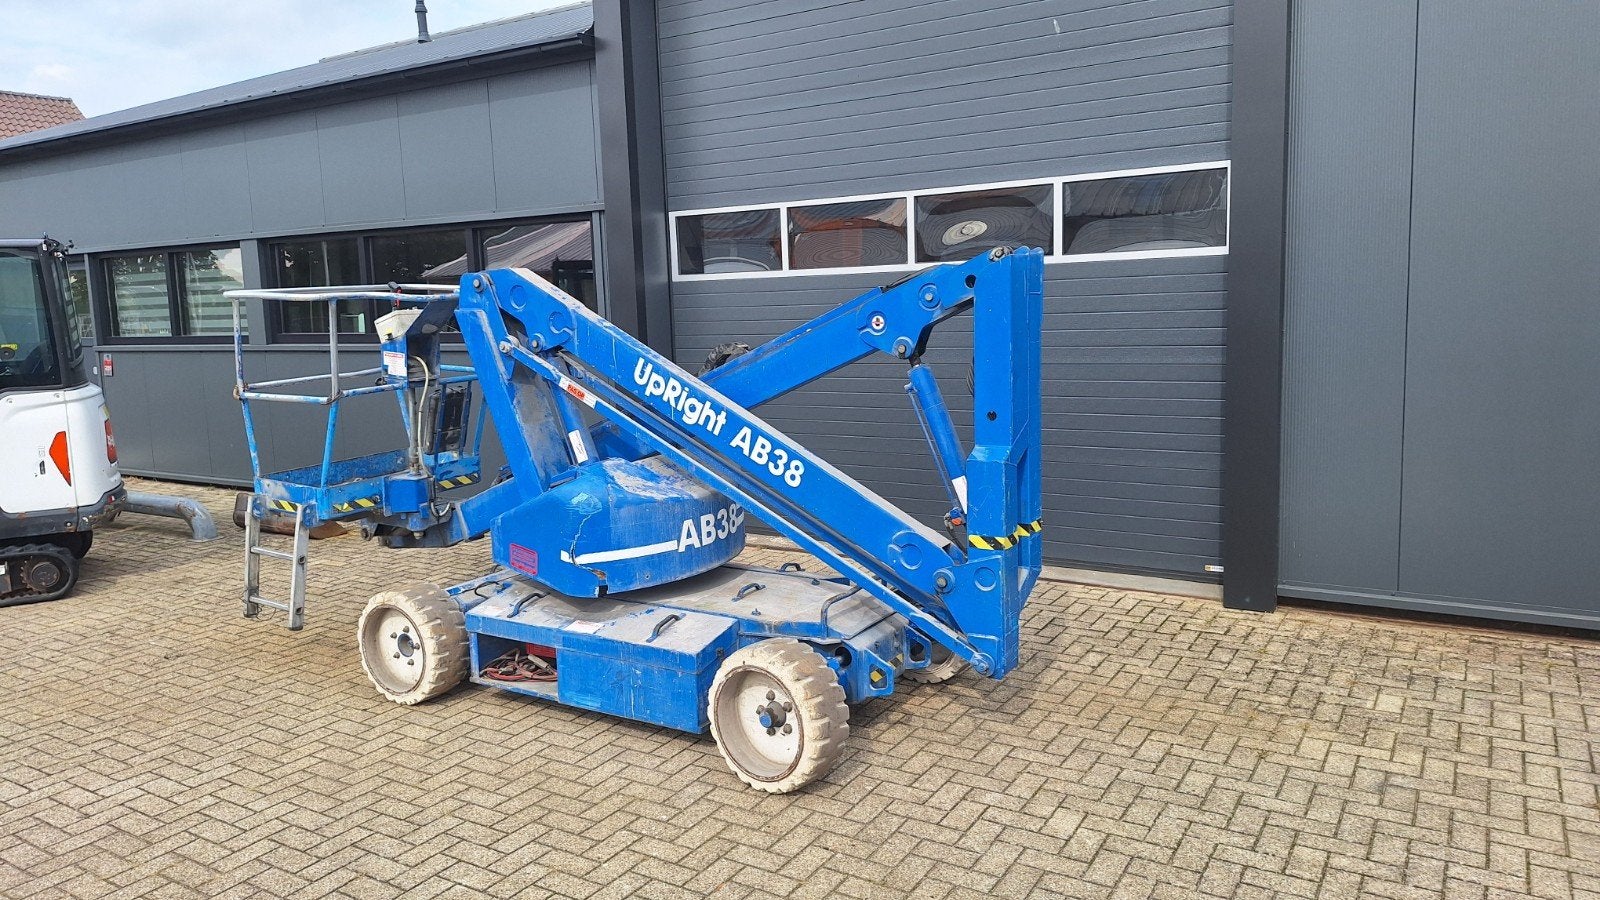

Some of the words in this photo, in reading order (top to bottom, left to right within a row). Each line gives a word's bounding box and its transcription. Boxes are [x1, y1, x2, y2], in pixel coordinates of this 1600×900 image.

[634, 357, 727, 436] UpRight
[729, 426, 805, 488] AB38
[678, 503, 737, 553] AB38
